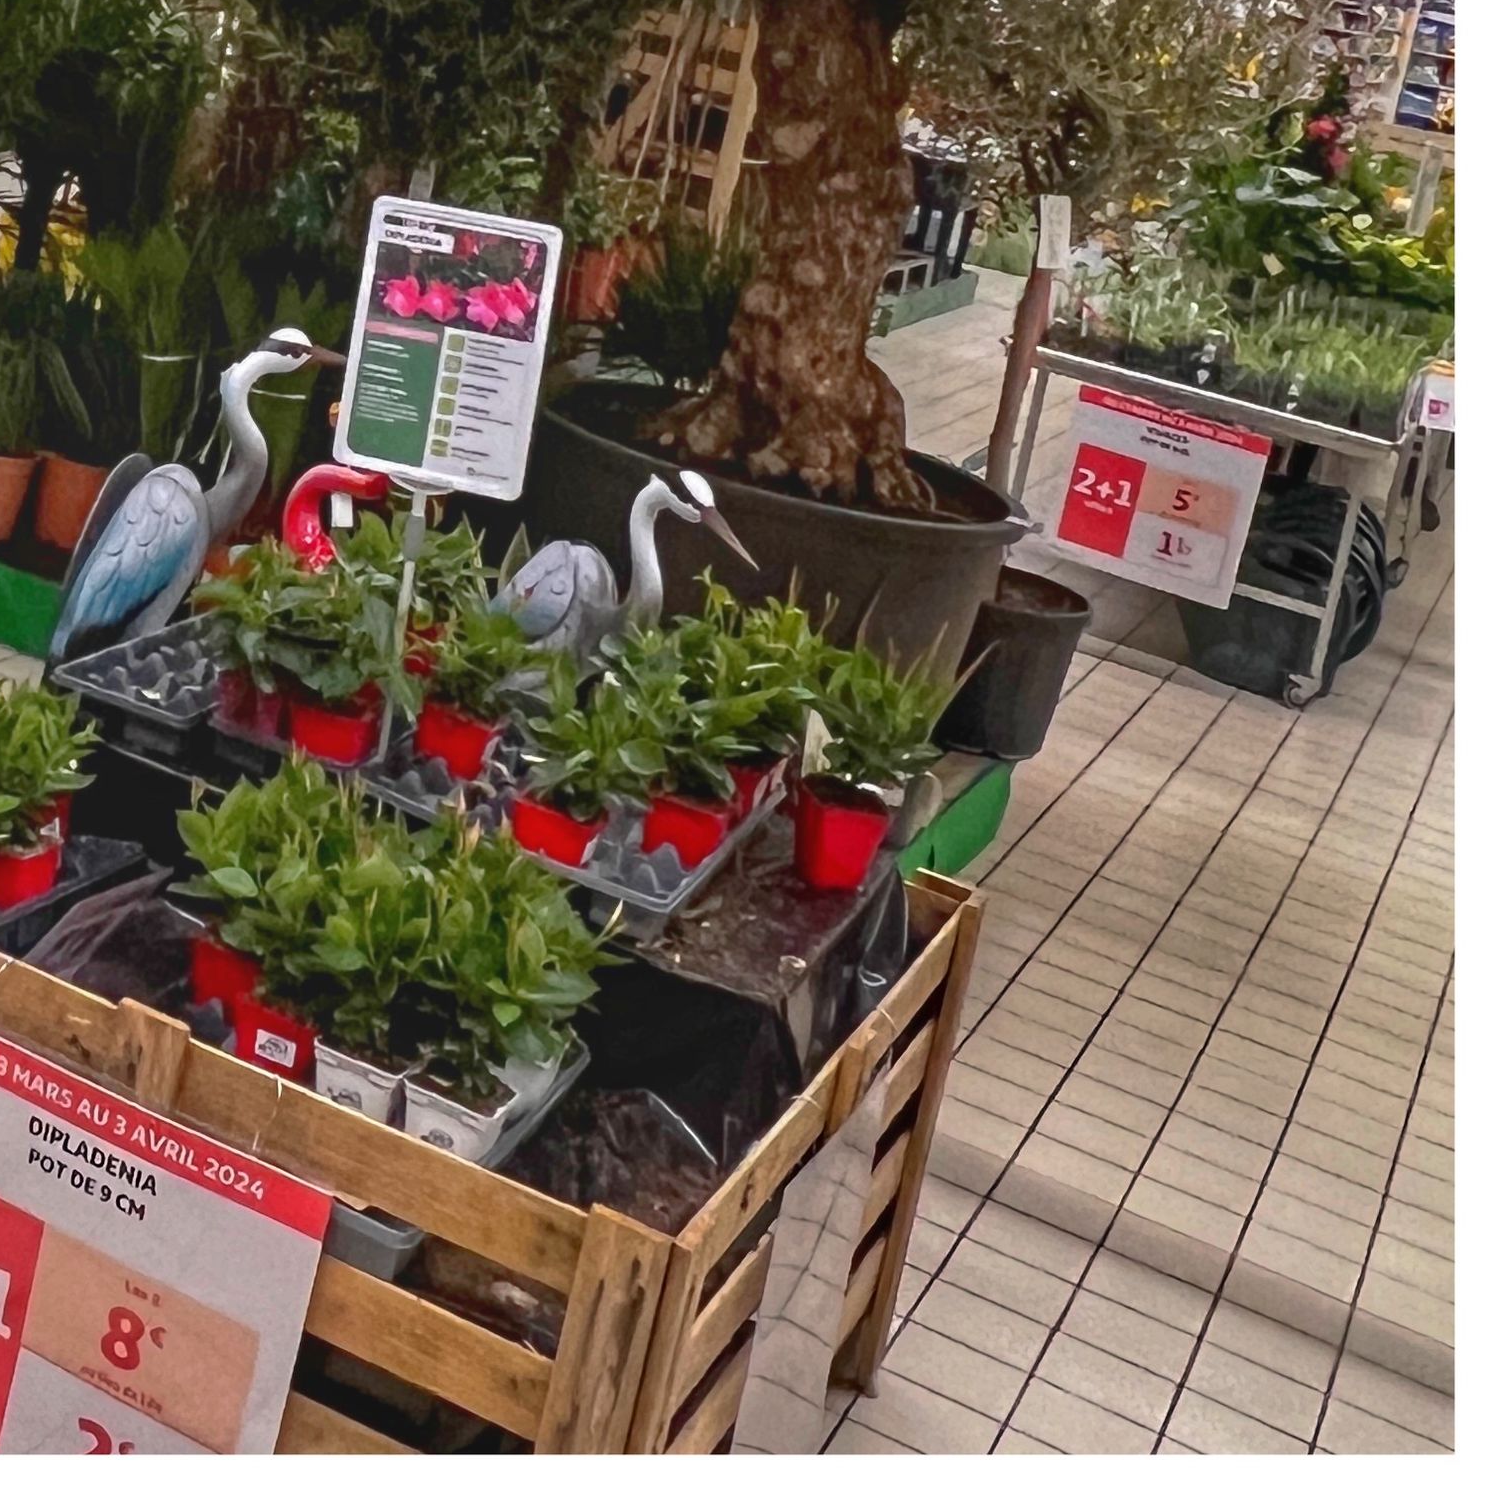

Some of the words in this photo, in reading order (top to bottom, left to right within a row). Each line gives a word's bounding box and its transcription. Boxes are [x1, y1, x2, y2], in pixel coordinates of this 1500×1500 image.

[1072, 467, 1132, 508] 2+1
[11, 1062, 72, 1109] MARS
[76, 1097, 110, 1127] AU
[112, 1114, 127, 1137] 3
[129, 1123, 199, 1172] AVRIL
[202, 1156, 265, 1201] 2024
[28, 1115, 158, 1197] DIPLADENIA
[28, 1147, 69, 1181] POT
[69, 1168, 96, 1197] DE
[99, 1183, 112, 1203] 9
[115, 1192, 147, 1221] CM
